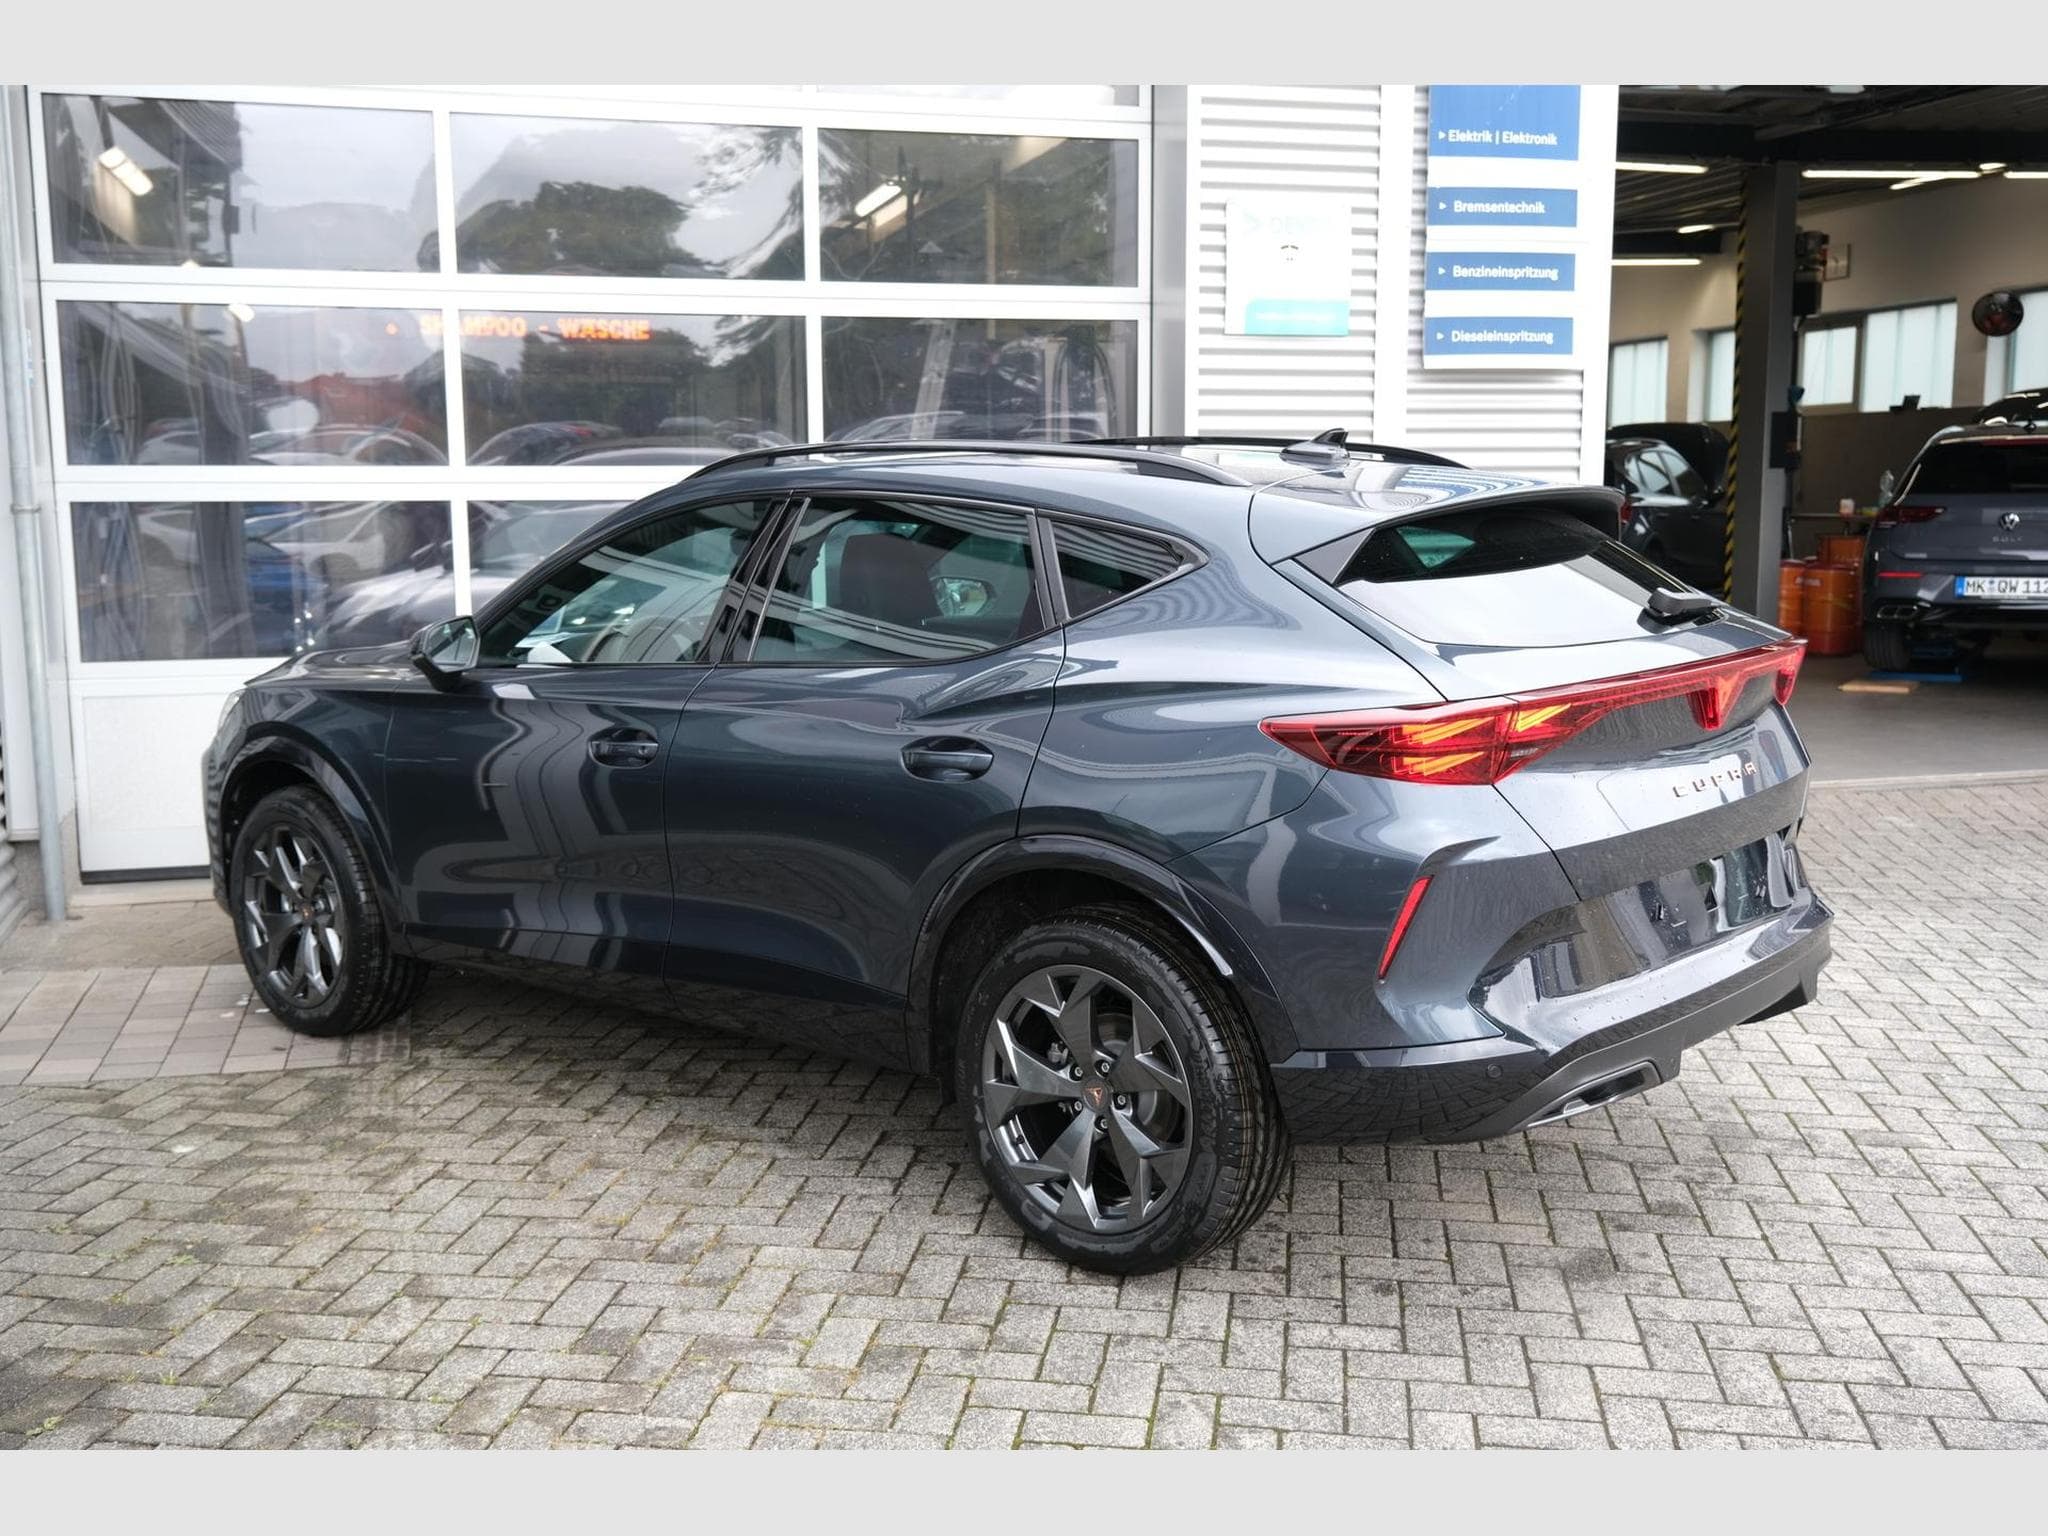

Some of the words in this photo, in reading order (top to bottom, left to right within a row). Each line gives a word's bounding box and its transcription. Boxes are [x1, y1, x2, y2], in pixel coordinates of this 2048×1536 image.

[1447, 129, 1493, 143] Elektrik
[1502, 131, 1558, 145] Elektronik
[1453, 200, 1546, 214] Bremsentechnik
[1453, 265, 1559, 281] Benzineinspritzung
[1451, 330, 1554, 345] Dieseleinspritzung
[1967, 580, 1986, 593] MK
[1672, 762, 1758, 798] CUPRA
